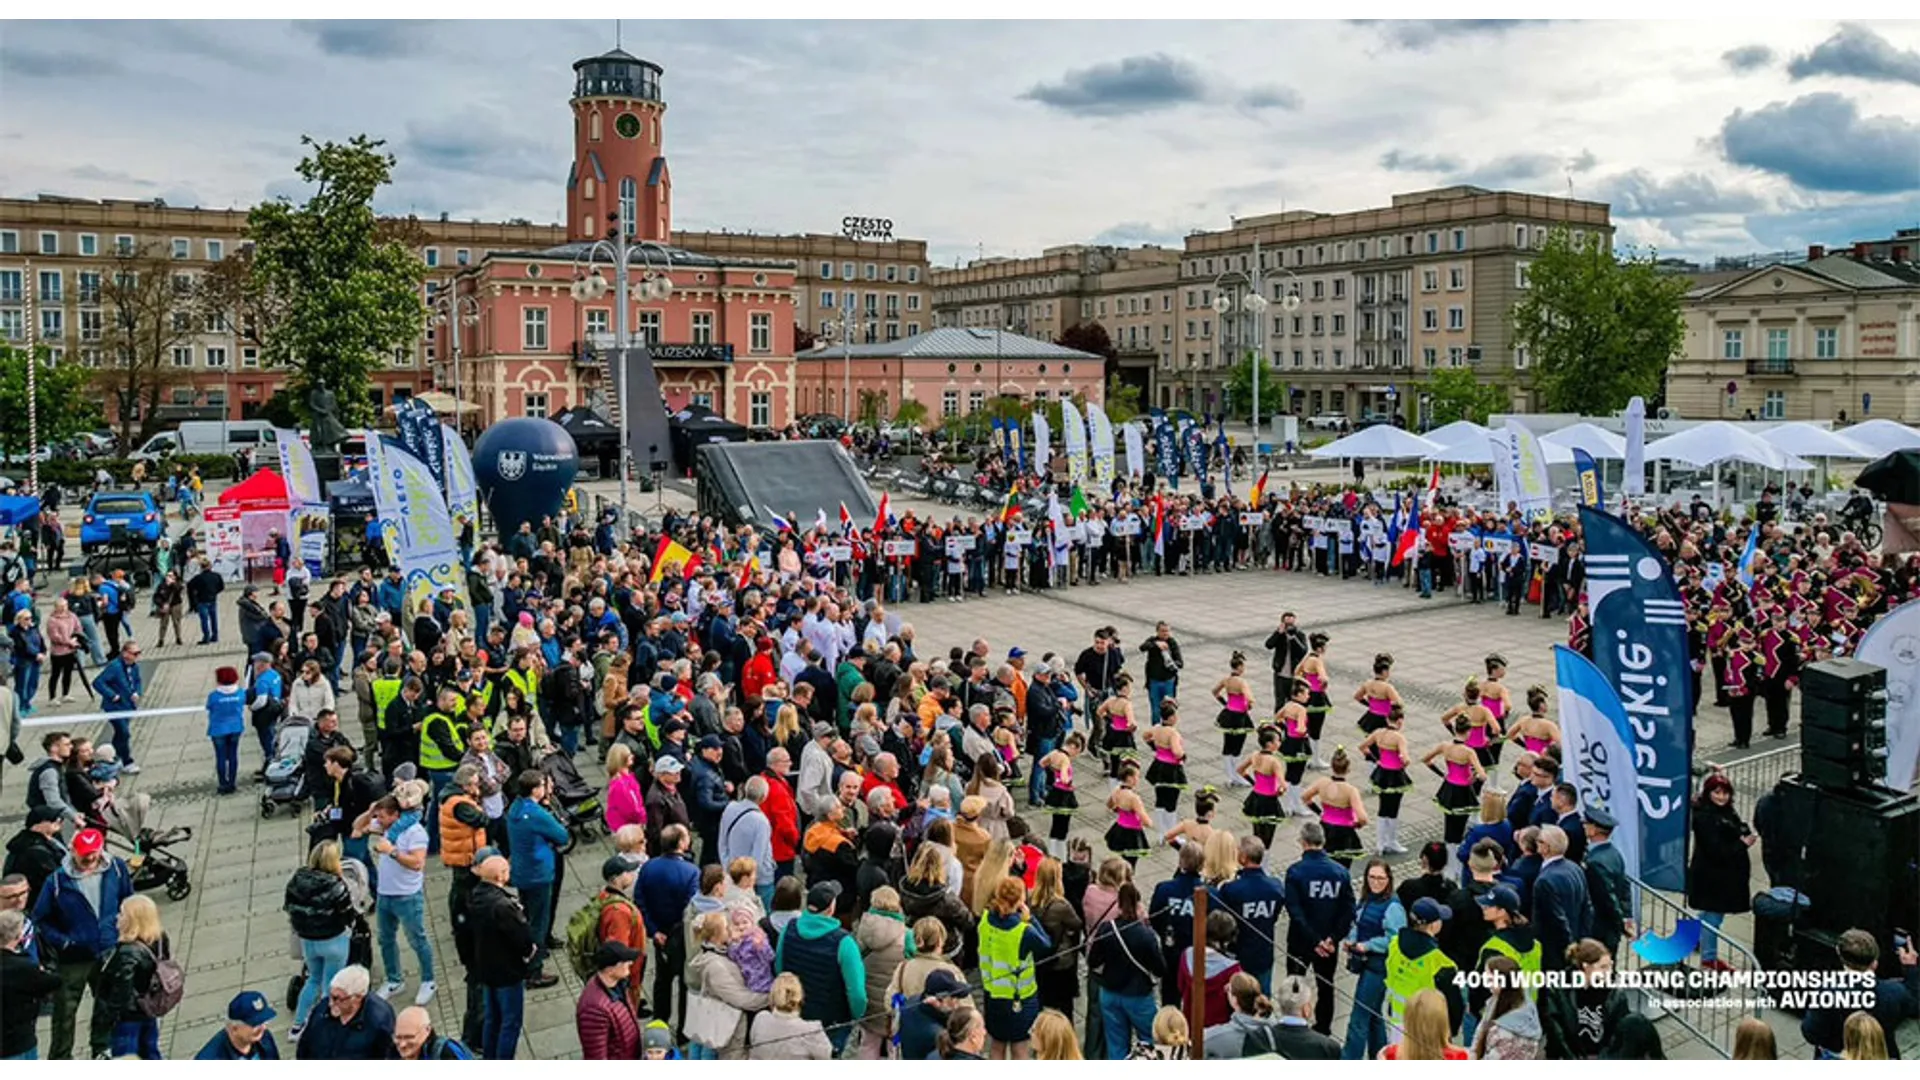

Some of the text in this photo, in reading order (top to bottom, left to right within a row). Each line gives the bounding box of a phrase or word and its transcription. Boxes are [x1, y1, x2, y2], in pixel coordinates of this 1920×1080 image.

[1309, 881, 1341, 899] FAI
[1168, 898, 1195, 917] FA
[1242, 900, 1276, 919] FAI
